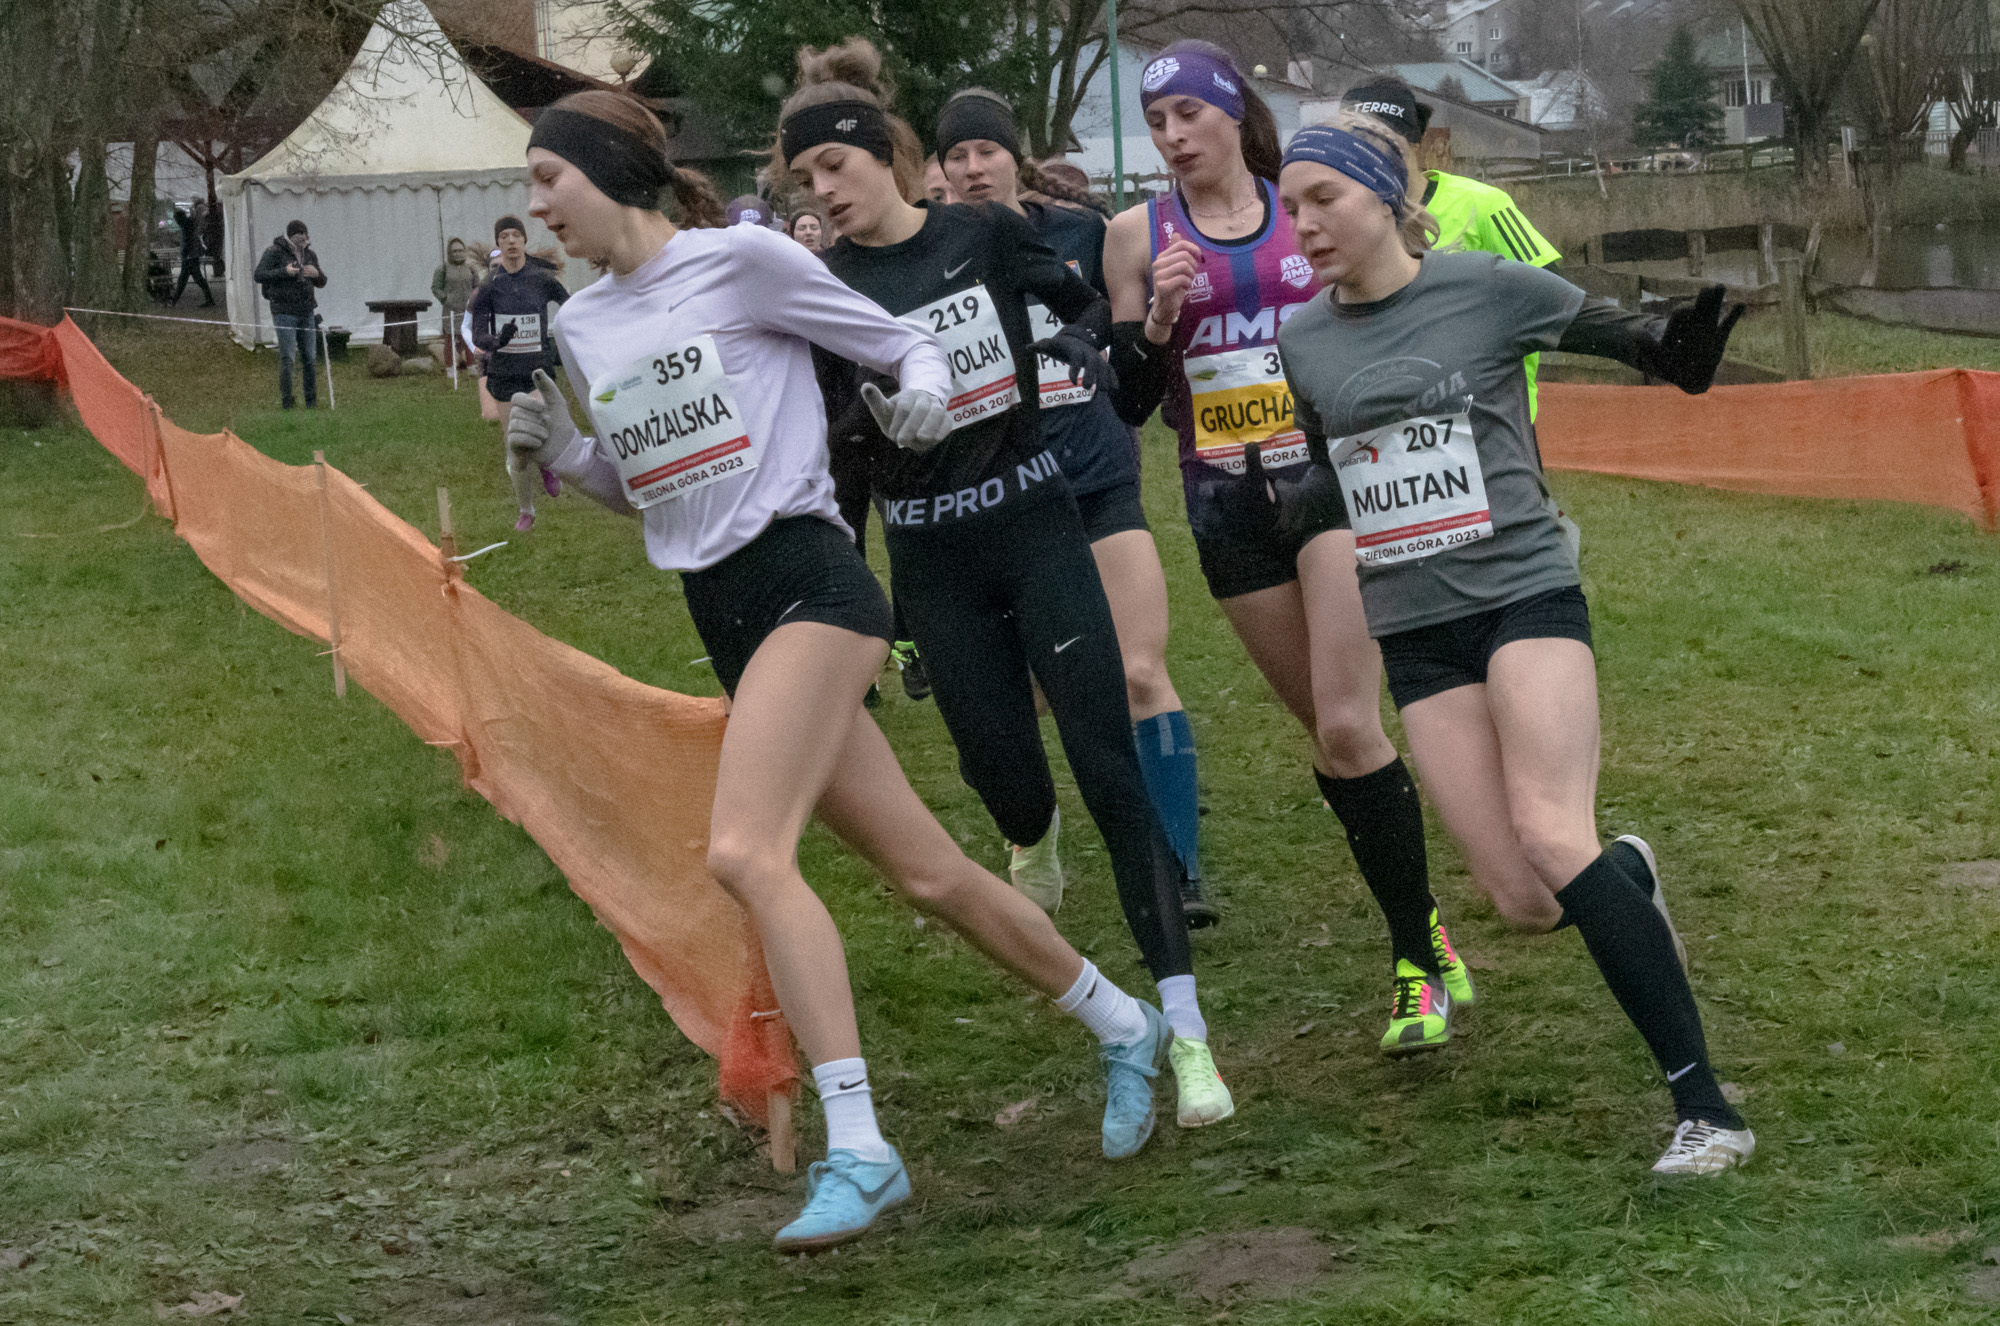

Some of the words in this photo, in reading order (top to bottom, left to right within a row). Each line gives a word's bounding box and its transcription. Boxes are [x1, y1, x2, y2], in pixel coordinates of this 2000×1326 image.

[835, 119, 858, 131] 4F
[1354, 102, 1405, 118] TERREX
[1281, 264, 1314, 282] AMS
[521, 316, 536, 324] 138
[929, 295, 979, 334] 219
[652, 346, 702, 385] 359
[948, 334, 1006, 379] OLAK
[1263, 352, 1281, 375] 3
[953, 403, 987, 423] GÓRA
[1046, 393, 1074, 404] GÓRA
[1201, 392, 1295, 433] GRUCHA
[610, 393, 733, 460] DOMŻALSKA
[1403, 418, 1454, 453] 207
[1262, 450, 1299, 464] GÓRA
[1338, 453, 1370, 470] polanik
[641, 482, 677, 502] ZIELONA
[677, 470, 710, 488] GÓRA
[711, 456, 744, 476] 2023
[1352, 466, 1471, 518] MULTAN
[885, 498, 927, 525] IKE
[933, 477, 1005, 522] PRO
[1364, 545, 1405, 562] ZIELONA
[1407, 537, 1444, 553] GÓRA
[1447, 529, 1480, 545] 2023
